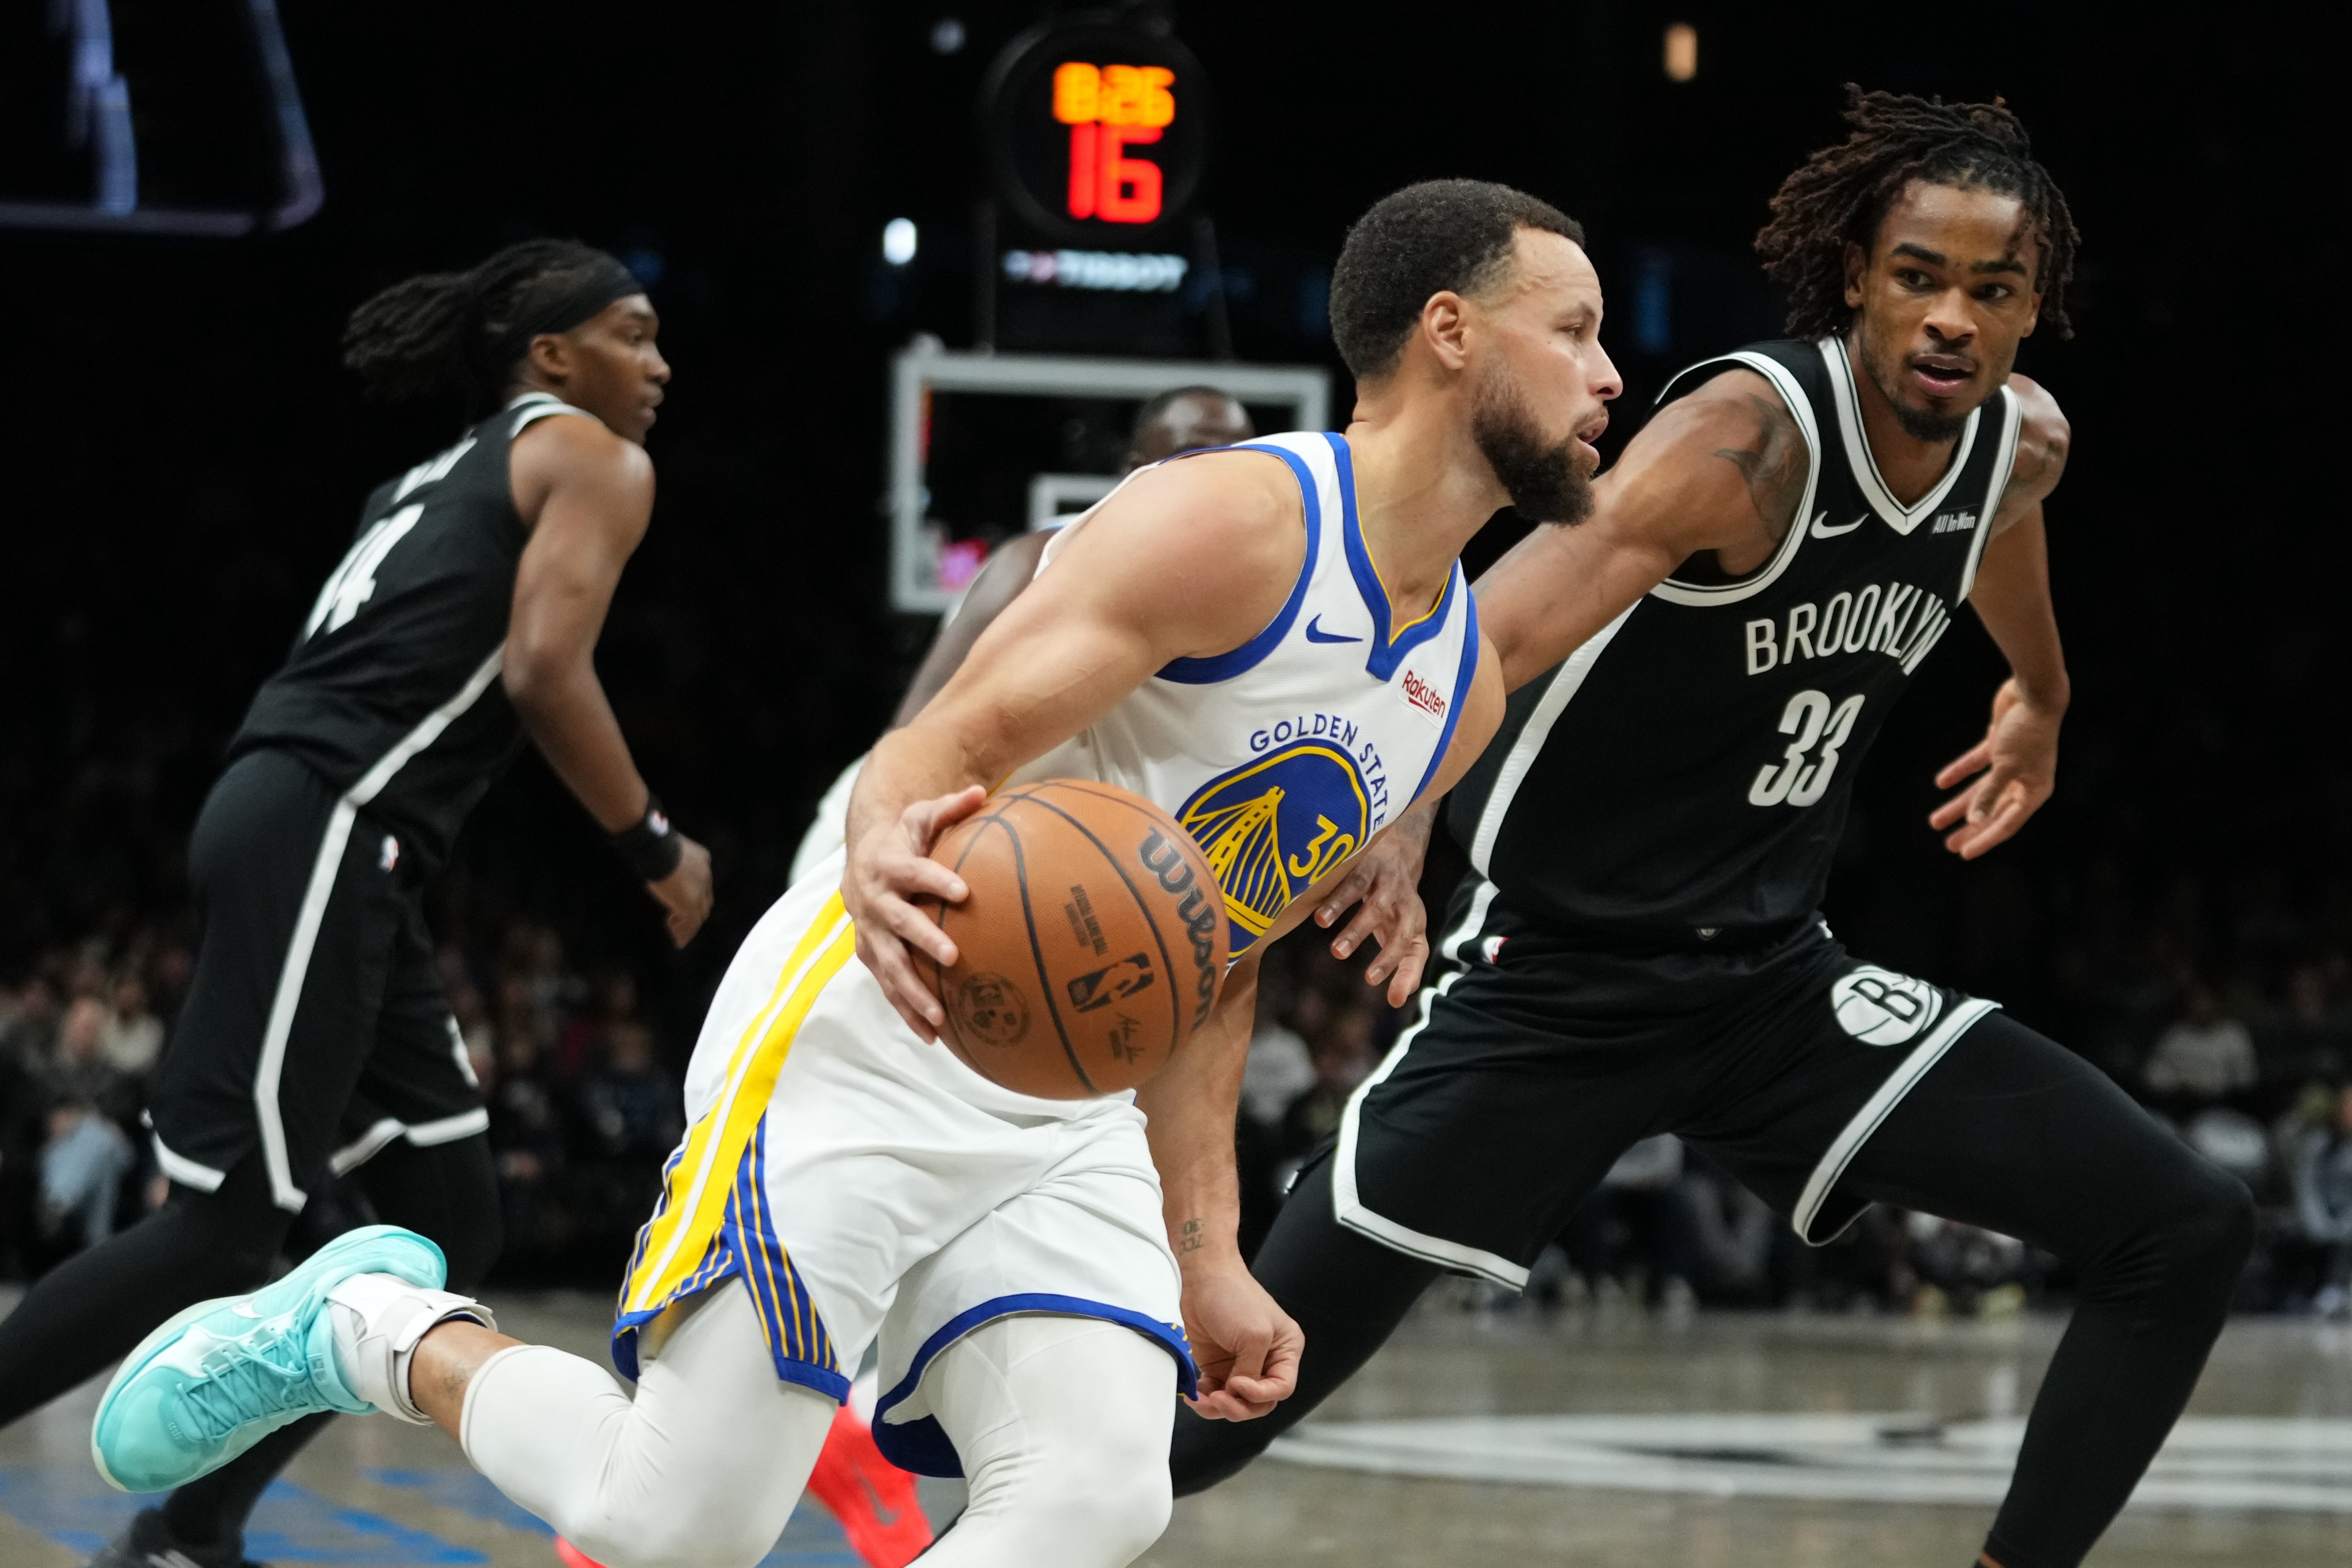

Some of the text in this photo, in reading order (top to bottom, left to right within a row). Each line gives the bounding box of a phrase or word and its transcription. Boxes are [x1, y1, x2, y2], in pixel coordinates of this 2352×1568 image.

[1068, 122, 1163, 223] 16
[1746, 582, 1951, 675] BROOKLYN
[1402, 670, 1446, 718] Rakuten
[1250, 714, 1388, 831] GOLDEN STATE
[1748, 690, 1865, 807] 33
[1289, 814, 1355, 885] 30
[1139, 826, 1216, 1036] Wilson
